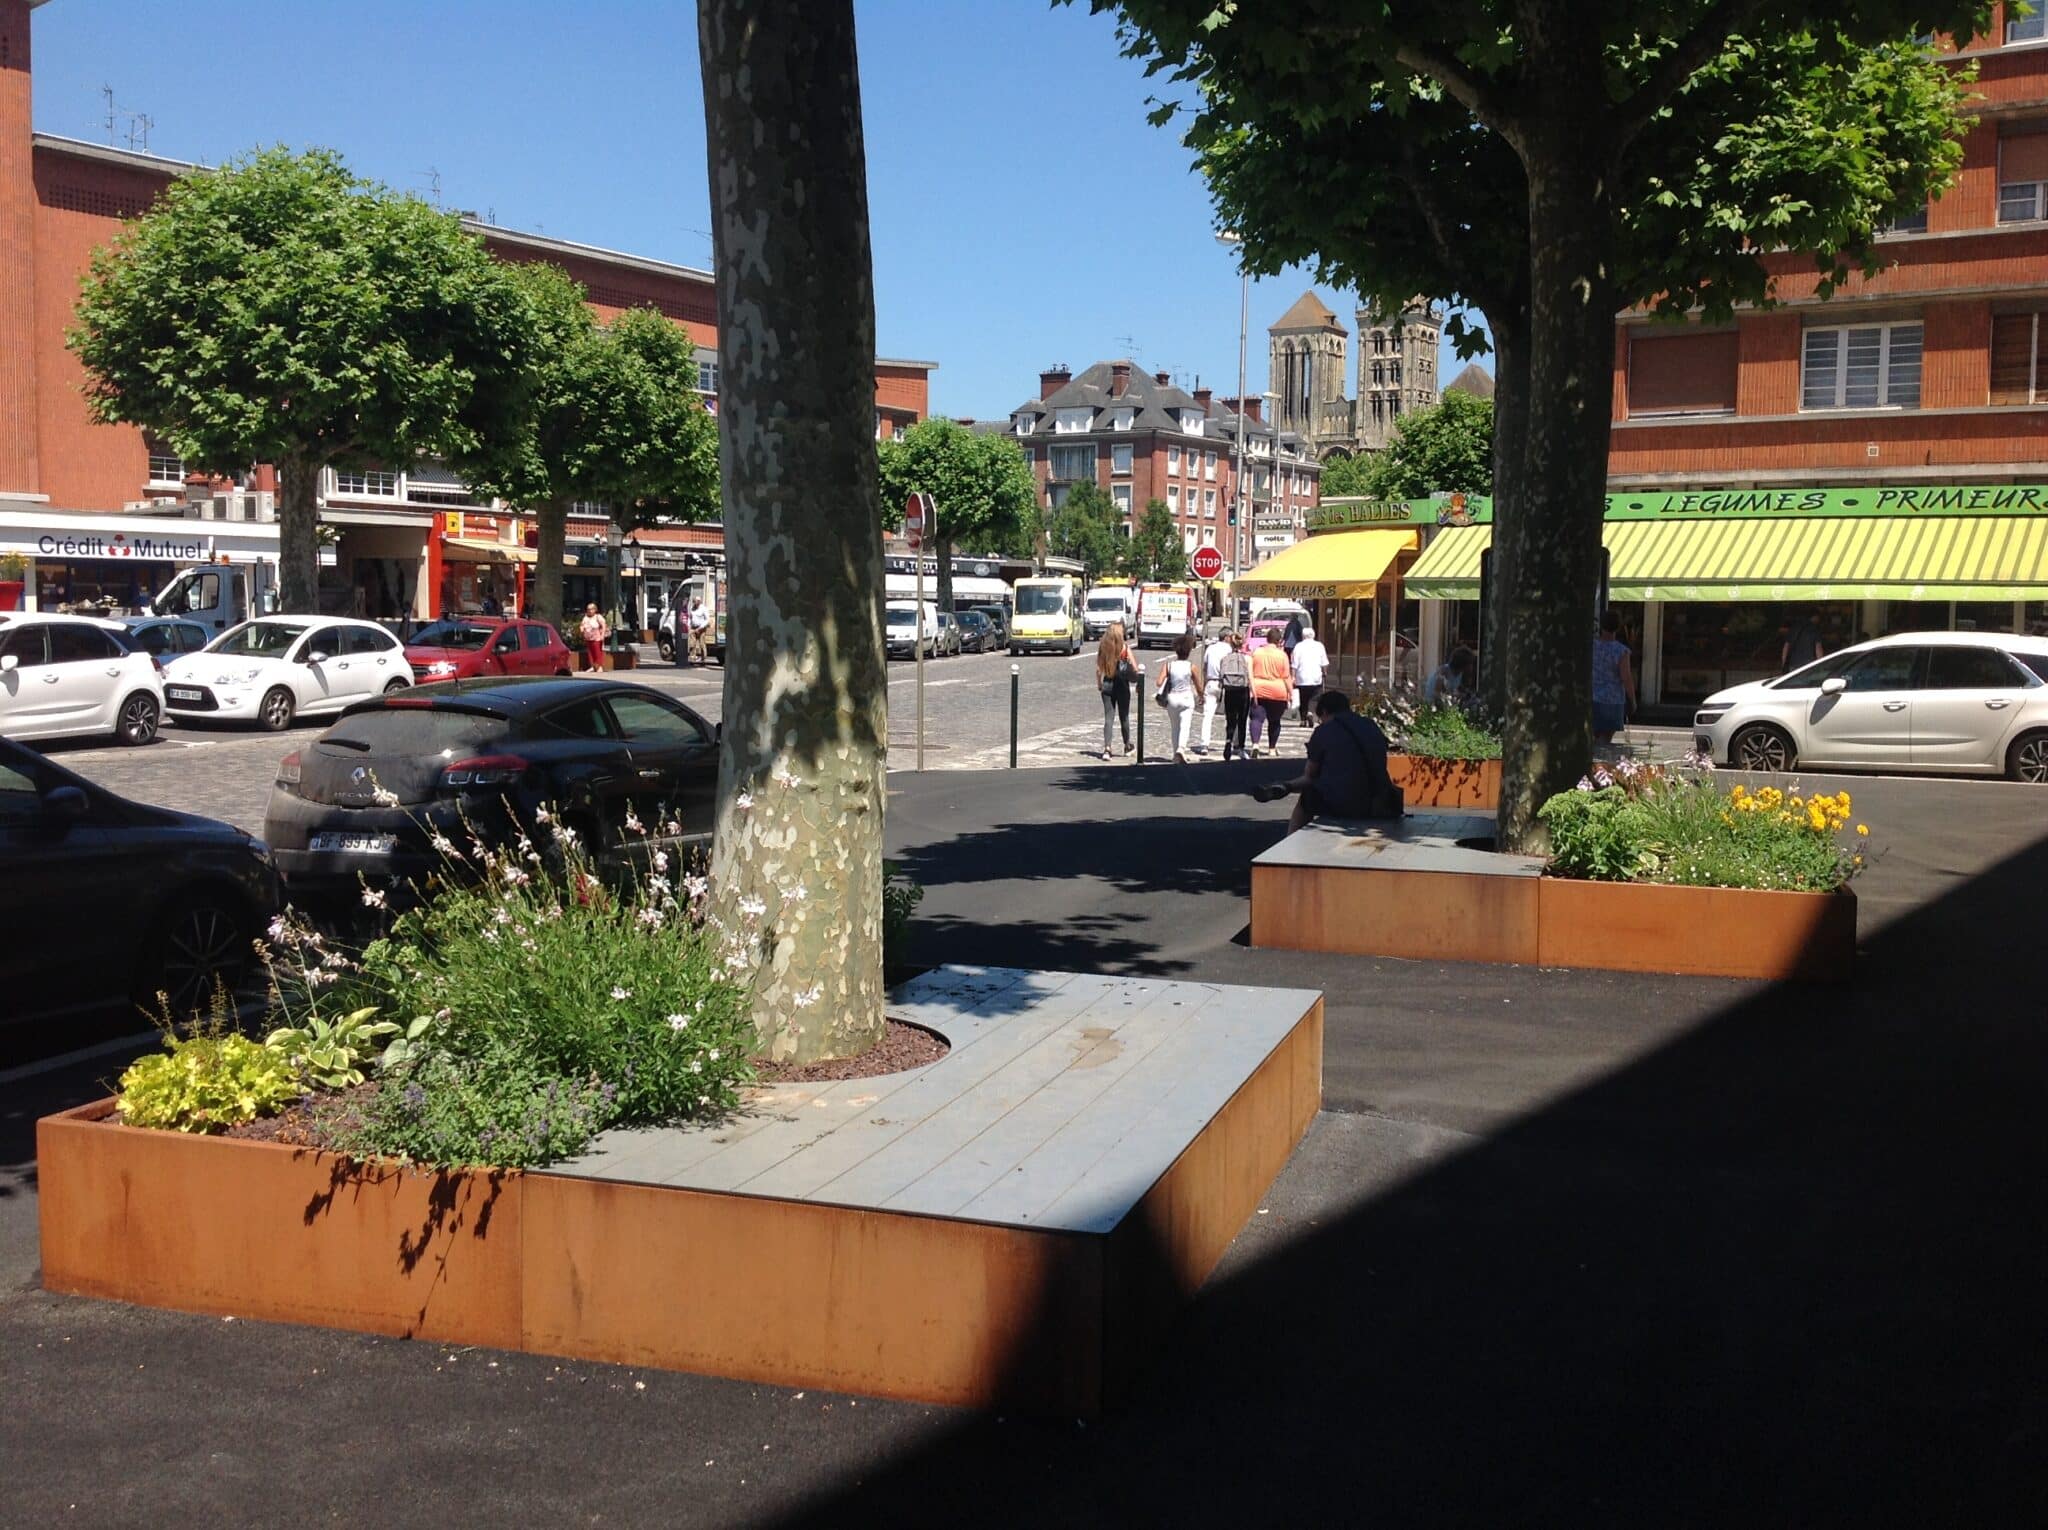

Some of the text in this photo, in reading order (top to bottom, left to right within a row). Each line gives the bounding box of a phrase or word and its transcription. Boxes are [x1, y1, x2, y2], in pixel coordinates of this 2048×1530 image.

[1660, 492, 1827, 514] LEGUMES
[1350, 502, 1412, 522] HALLES
[38, 535, 201, 559] Crédit Mutuel
[893, 560, 905, 569] LE
[1195, 557, 1220, 568] STOP
[1275, 584, 1337, 598] PRIMEURS
